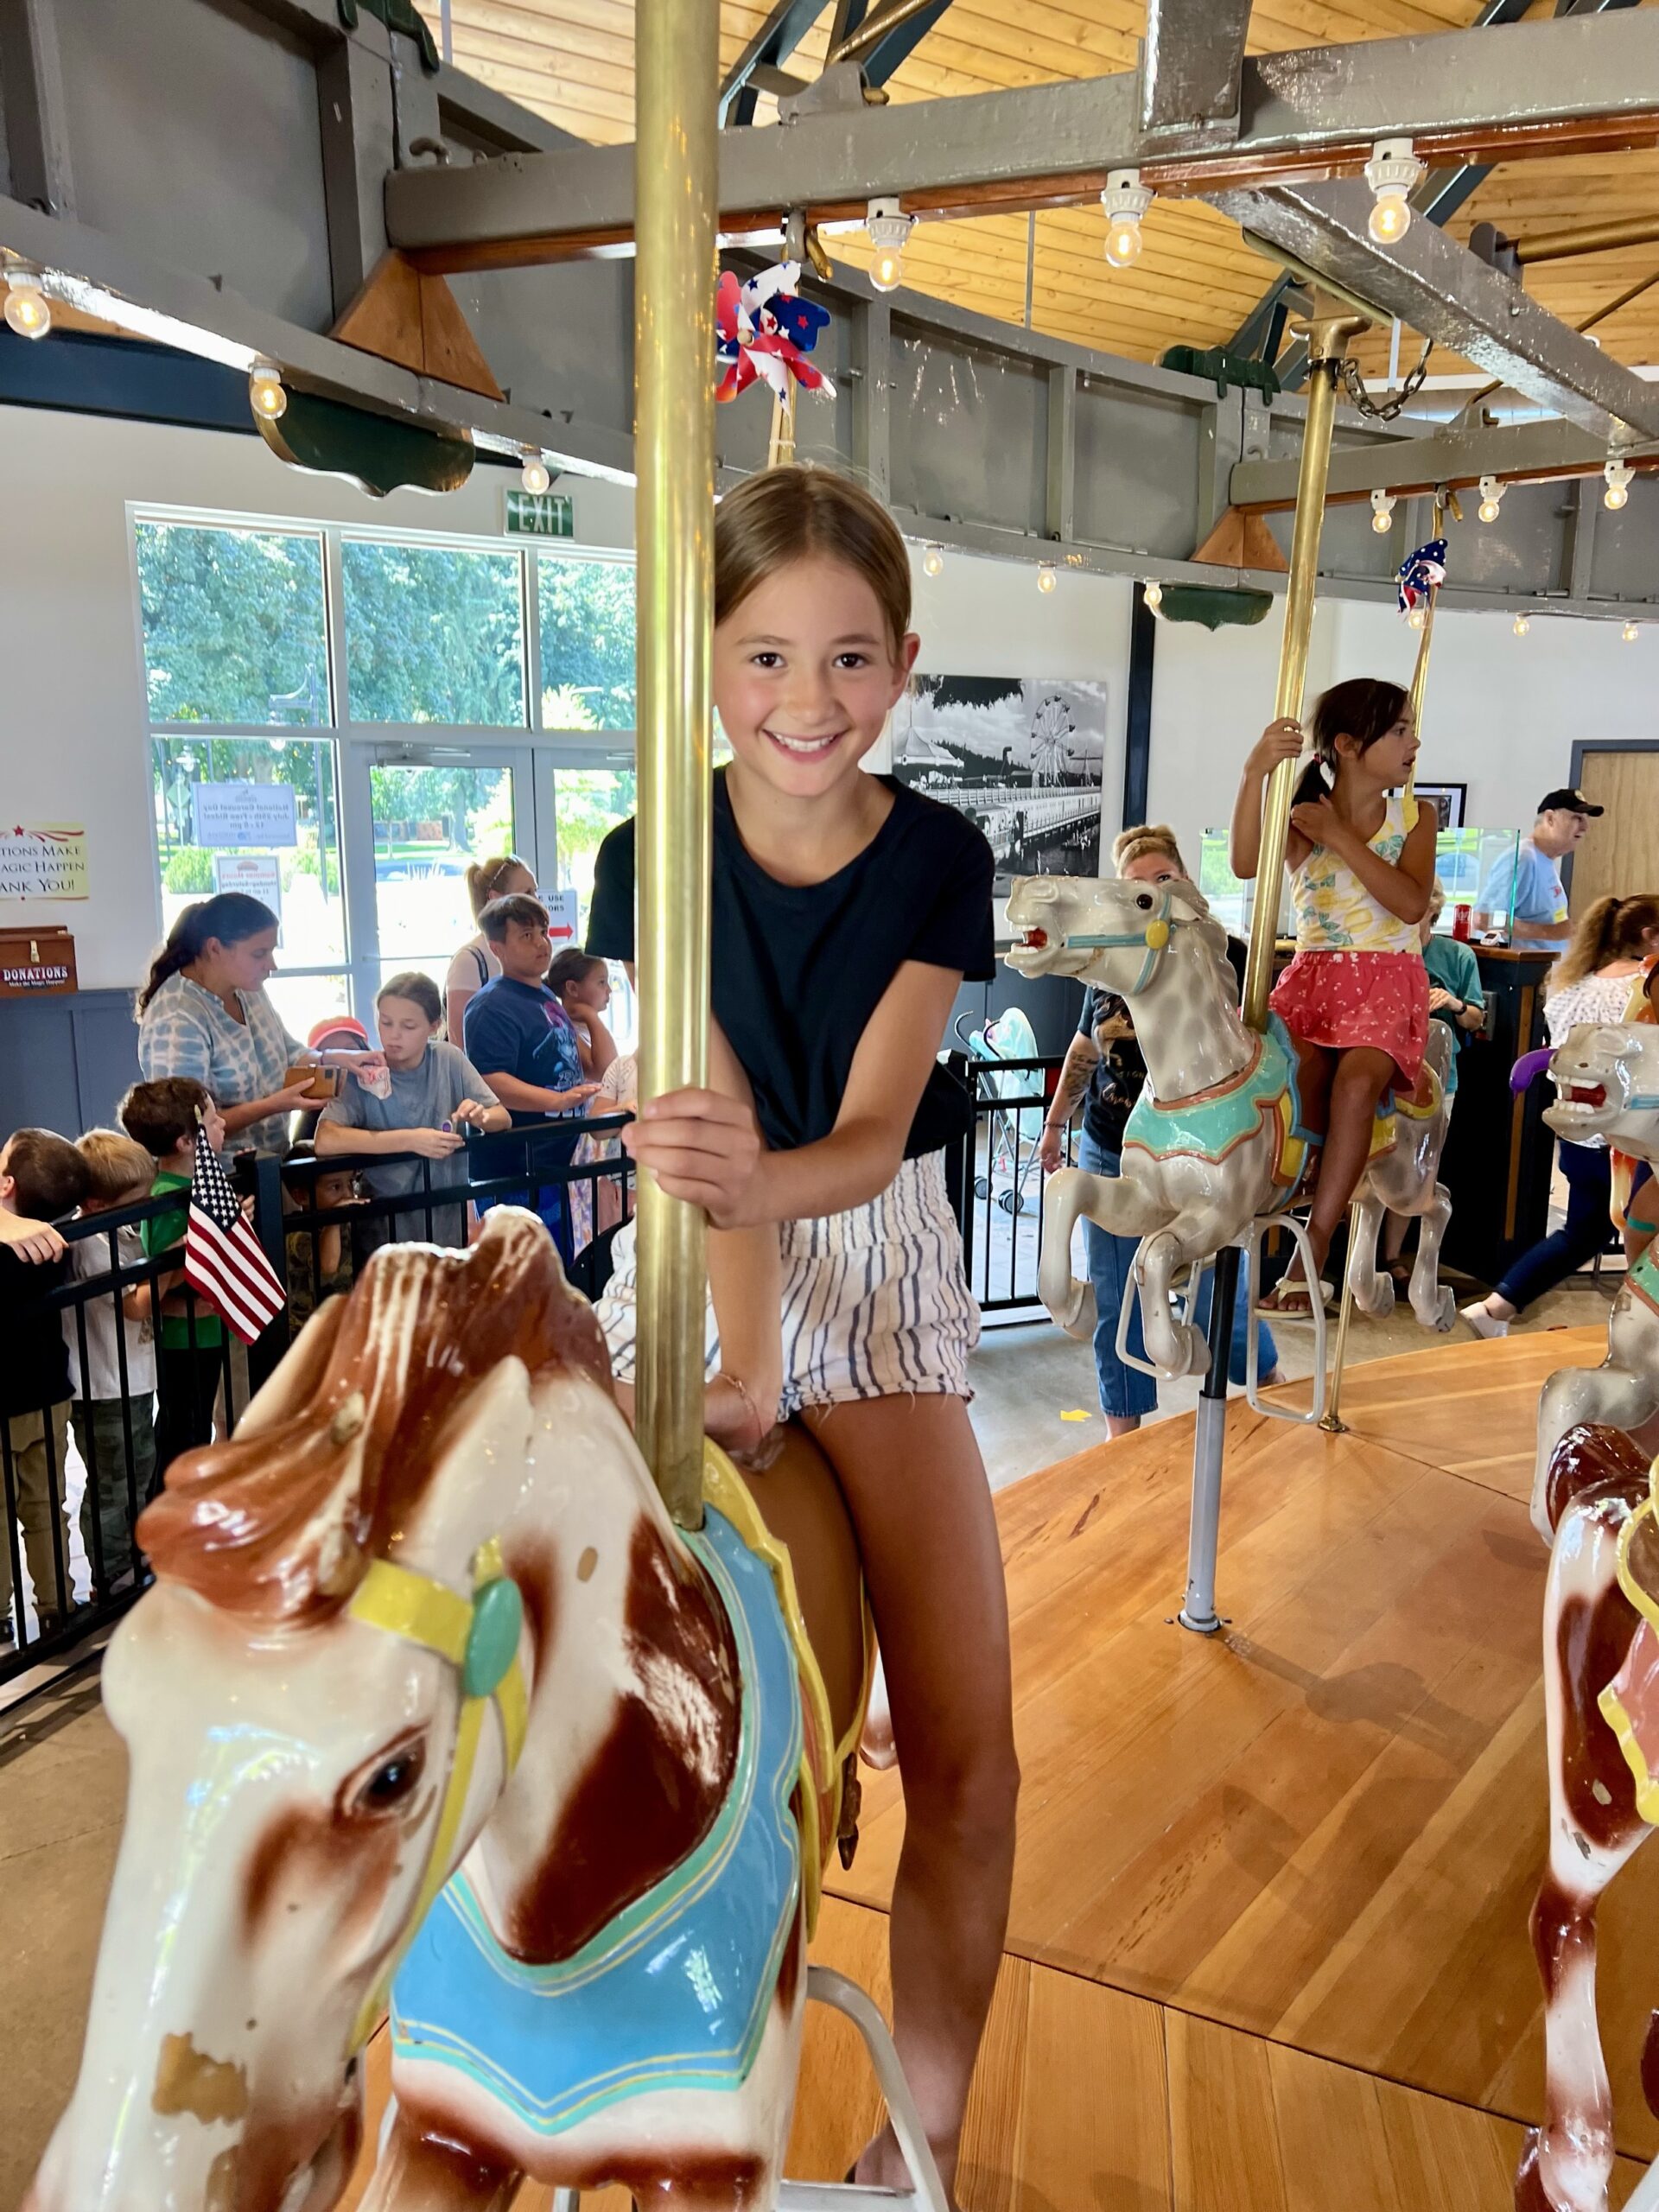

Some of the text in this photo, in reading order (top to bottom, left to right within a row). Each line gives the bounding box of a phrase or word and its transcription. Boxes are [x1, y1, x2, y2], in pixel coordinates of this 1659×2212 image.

[518, 493, 565, 534] EXIT
[1, 845, 80, 856] TIONS MAKE
[1, 861, 85, 873] AGIC HAPPEN
[0, 878, 74, 892] ANK YOU!
[3, 966, 68, 982] DONATIONS
